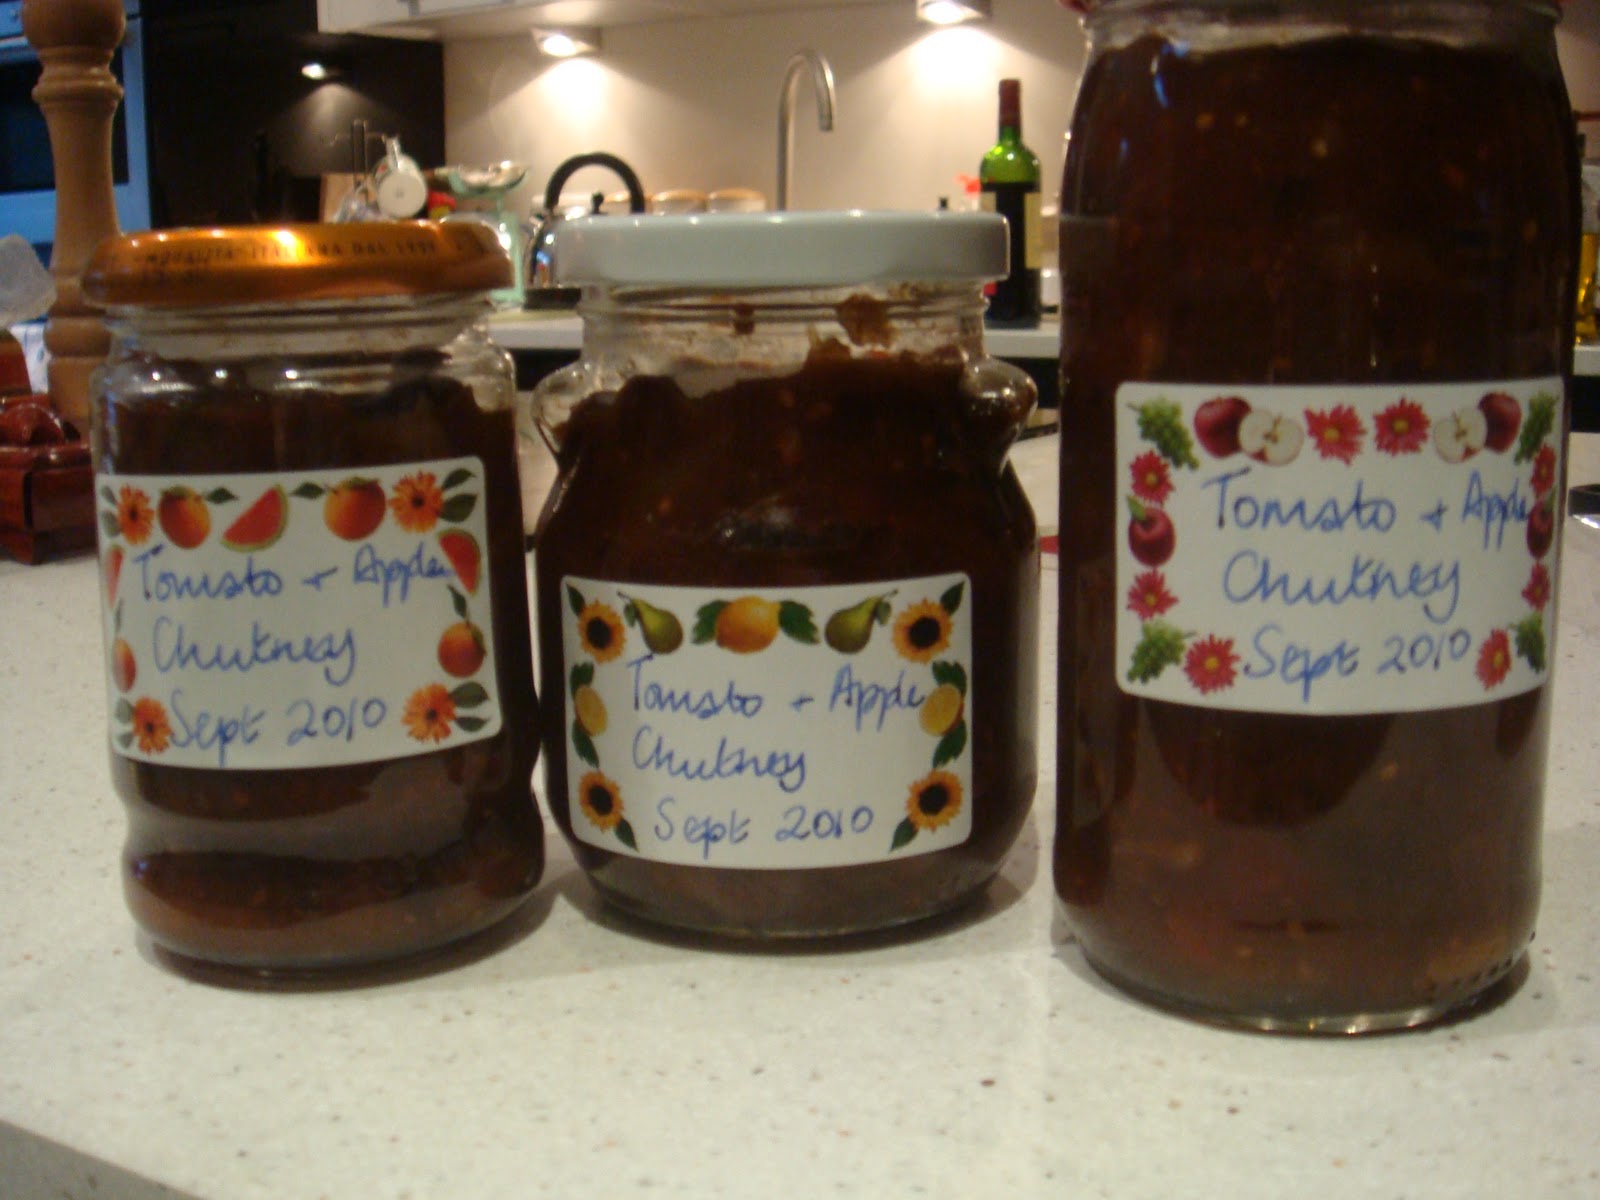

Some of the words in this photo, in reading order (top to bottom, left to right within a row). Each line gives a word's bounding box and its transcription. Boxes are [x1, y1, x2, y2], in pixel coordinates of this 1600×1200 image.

[1202, 467, 1397, 532] Tomato
[1461, 470, 1531, 551] Apple
[133, 543, 283, 601] Tomato
[353, 541, 453, 607] Apple
[1223, 549, 1461, 624] Chutney
[153, 615, 356, 686] Chutney
[1244, 623, 1360, 702] Sept
[1376, 628, 1471, 675] 2010
[170, 688, 267, 767] Sept
[286, 697, 387, 746] 2010
[627, 653, 764, 719] Tomato
[828, 662, 926, 732] Apple
[632, 724, 806, 792] Chutney
[654, 796, 750, 859] Sept
[775, 805, 874, 839] 2010
